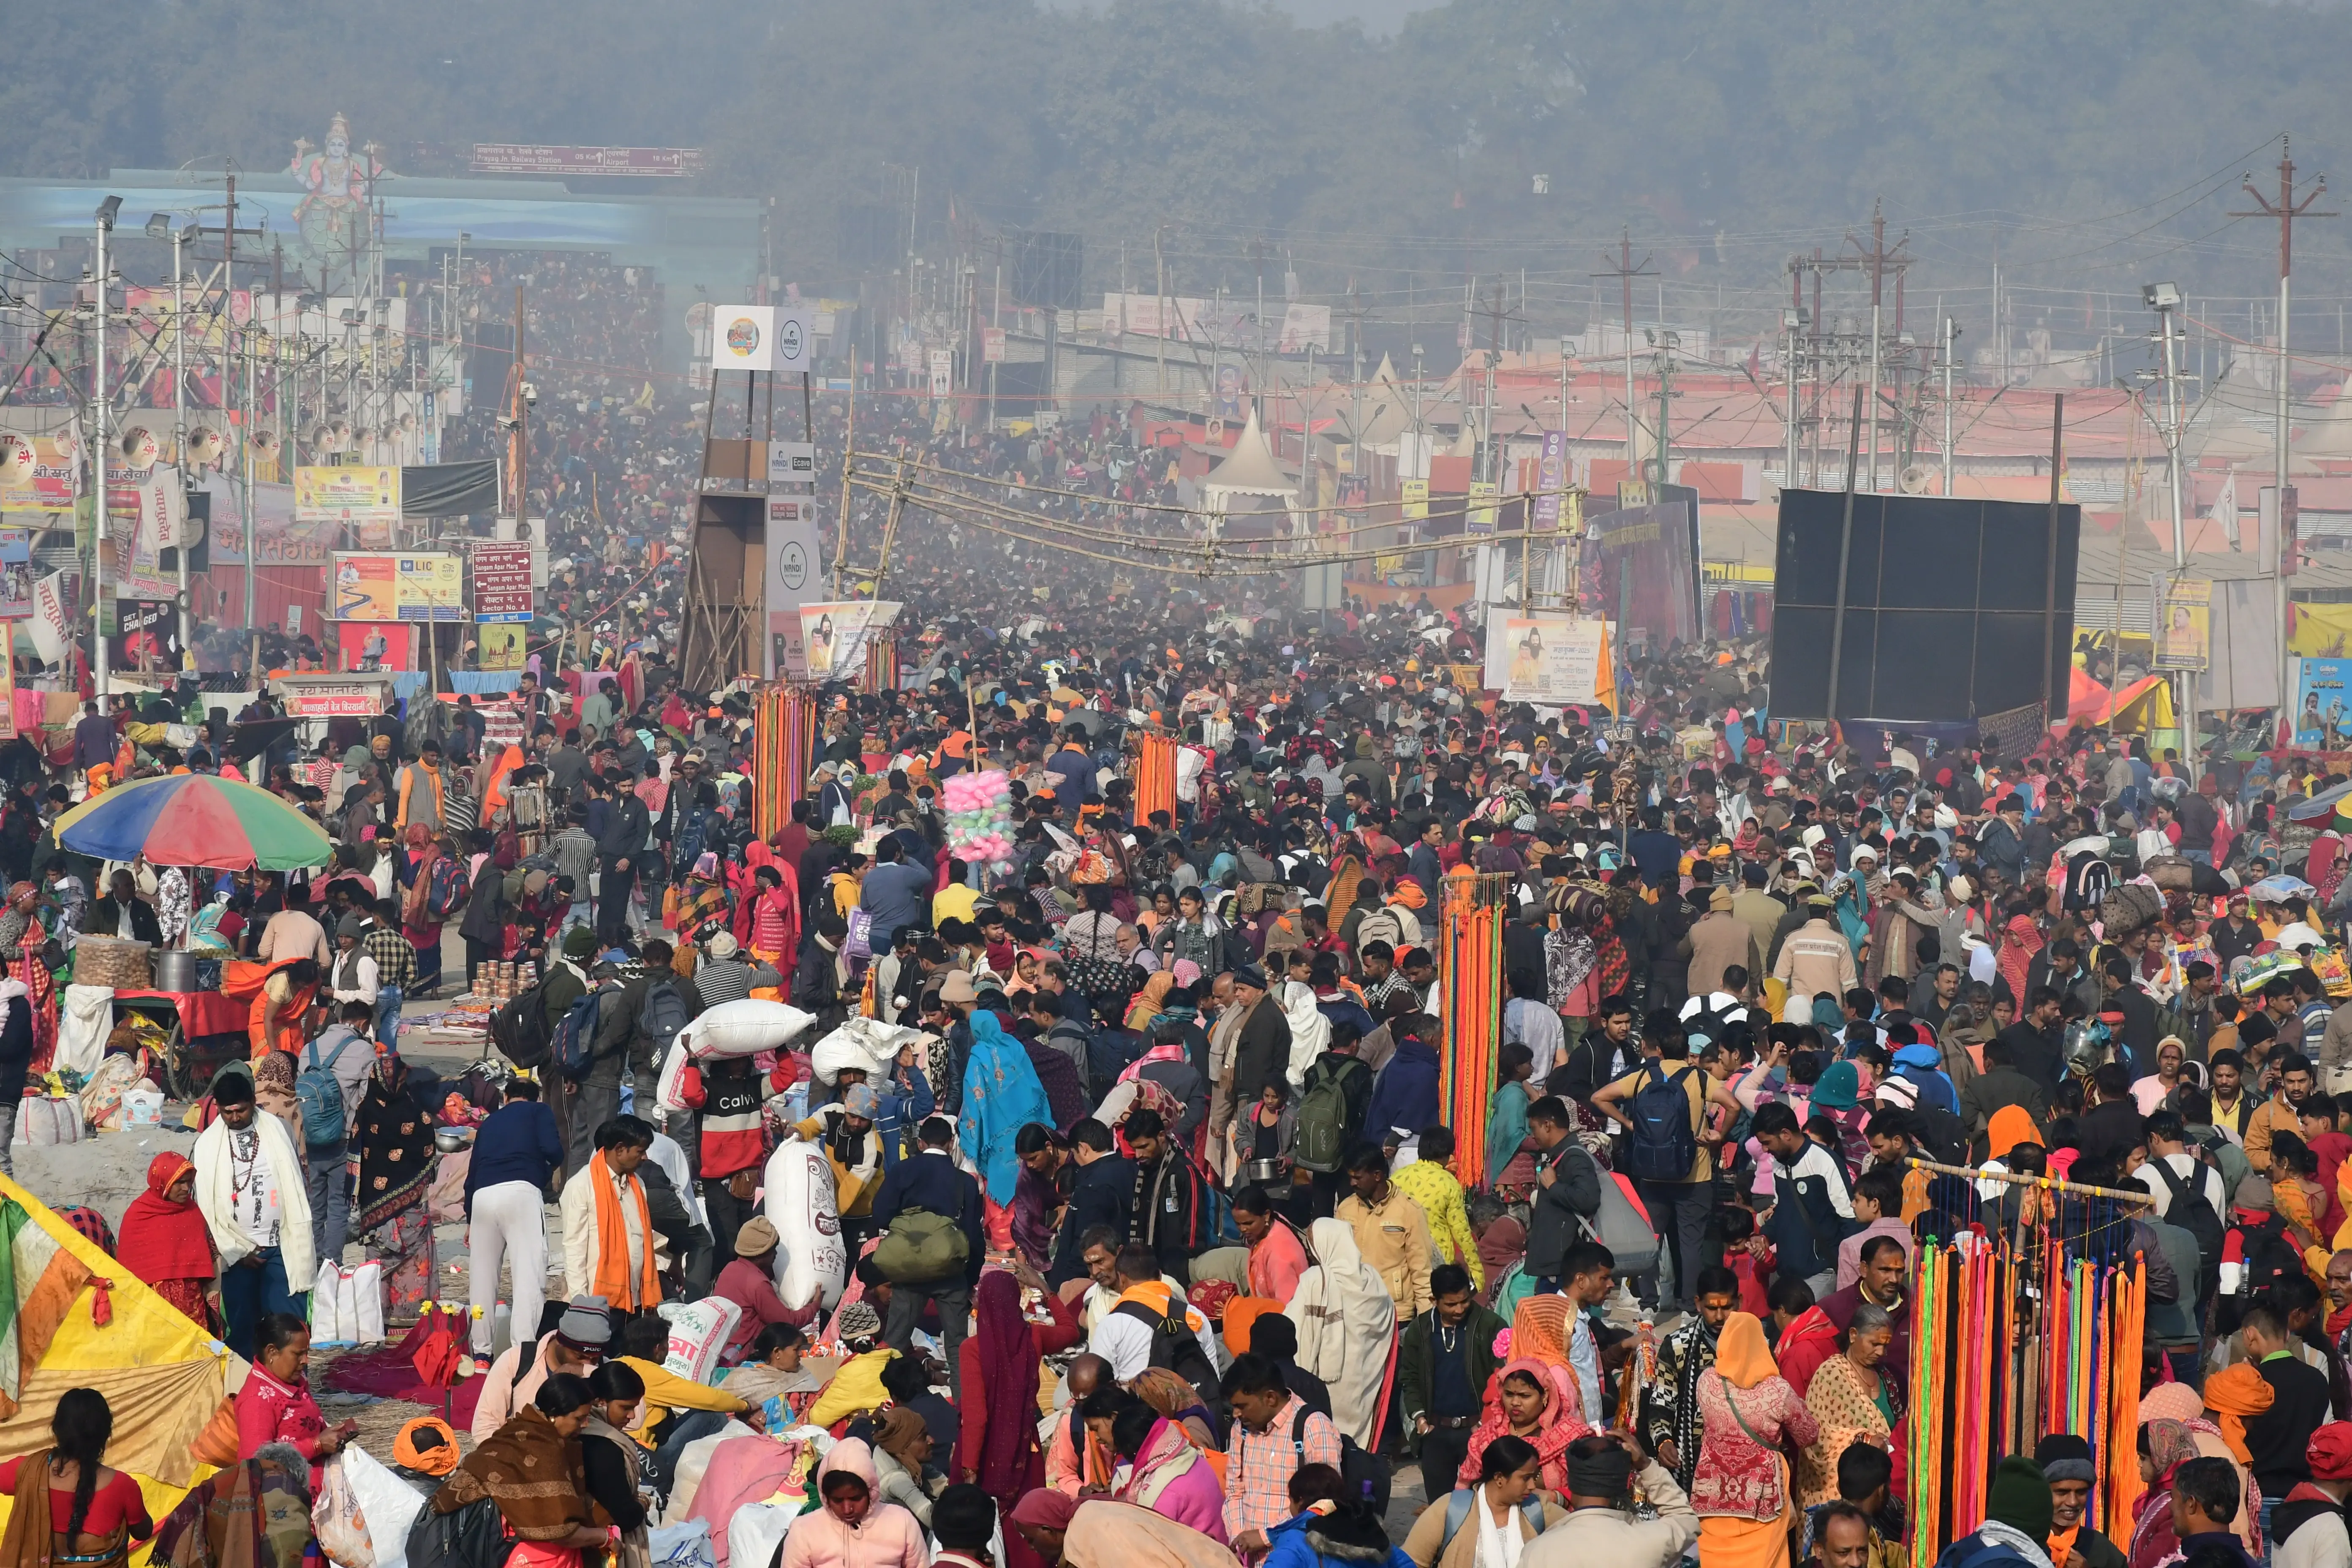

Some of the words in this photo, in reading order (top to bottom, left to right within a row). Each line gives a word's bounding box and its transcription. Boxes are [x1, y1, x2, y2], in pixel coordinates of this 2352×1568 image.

[519, 147, 532, 155] रेलवे
[536, 147, 553, 155] स्टेशन
[477, 155, 499, 163] Prayag
[512, 156, 536, 164] Railway
[48, 468, 72, 481] सतु
[122, 468, 148, 479] सेवा
[475, 554, 487, 562] संगम
[503, 553, 512, 561] मार्ग
[416, 561, 432, 571] LIC
[784, 564, 801, 572] NANDI
[487, 574, 499, 583] संगम
[484, 595, 504, 604] सेक्टर
[124, 613, 136, 622] GET
[124, 612, 158, 632] CHAGED
[296, 686, 316, 696] जय
[319, 686, 350, 695] माता
[351, 682, 364, 695] दी
[302, 700, 329, 712] शाकाहारी
[342, 700, 365, 711] बिरयानी
